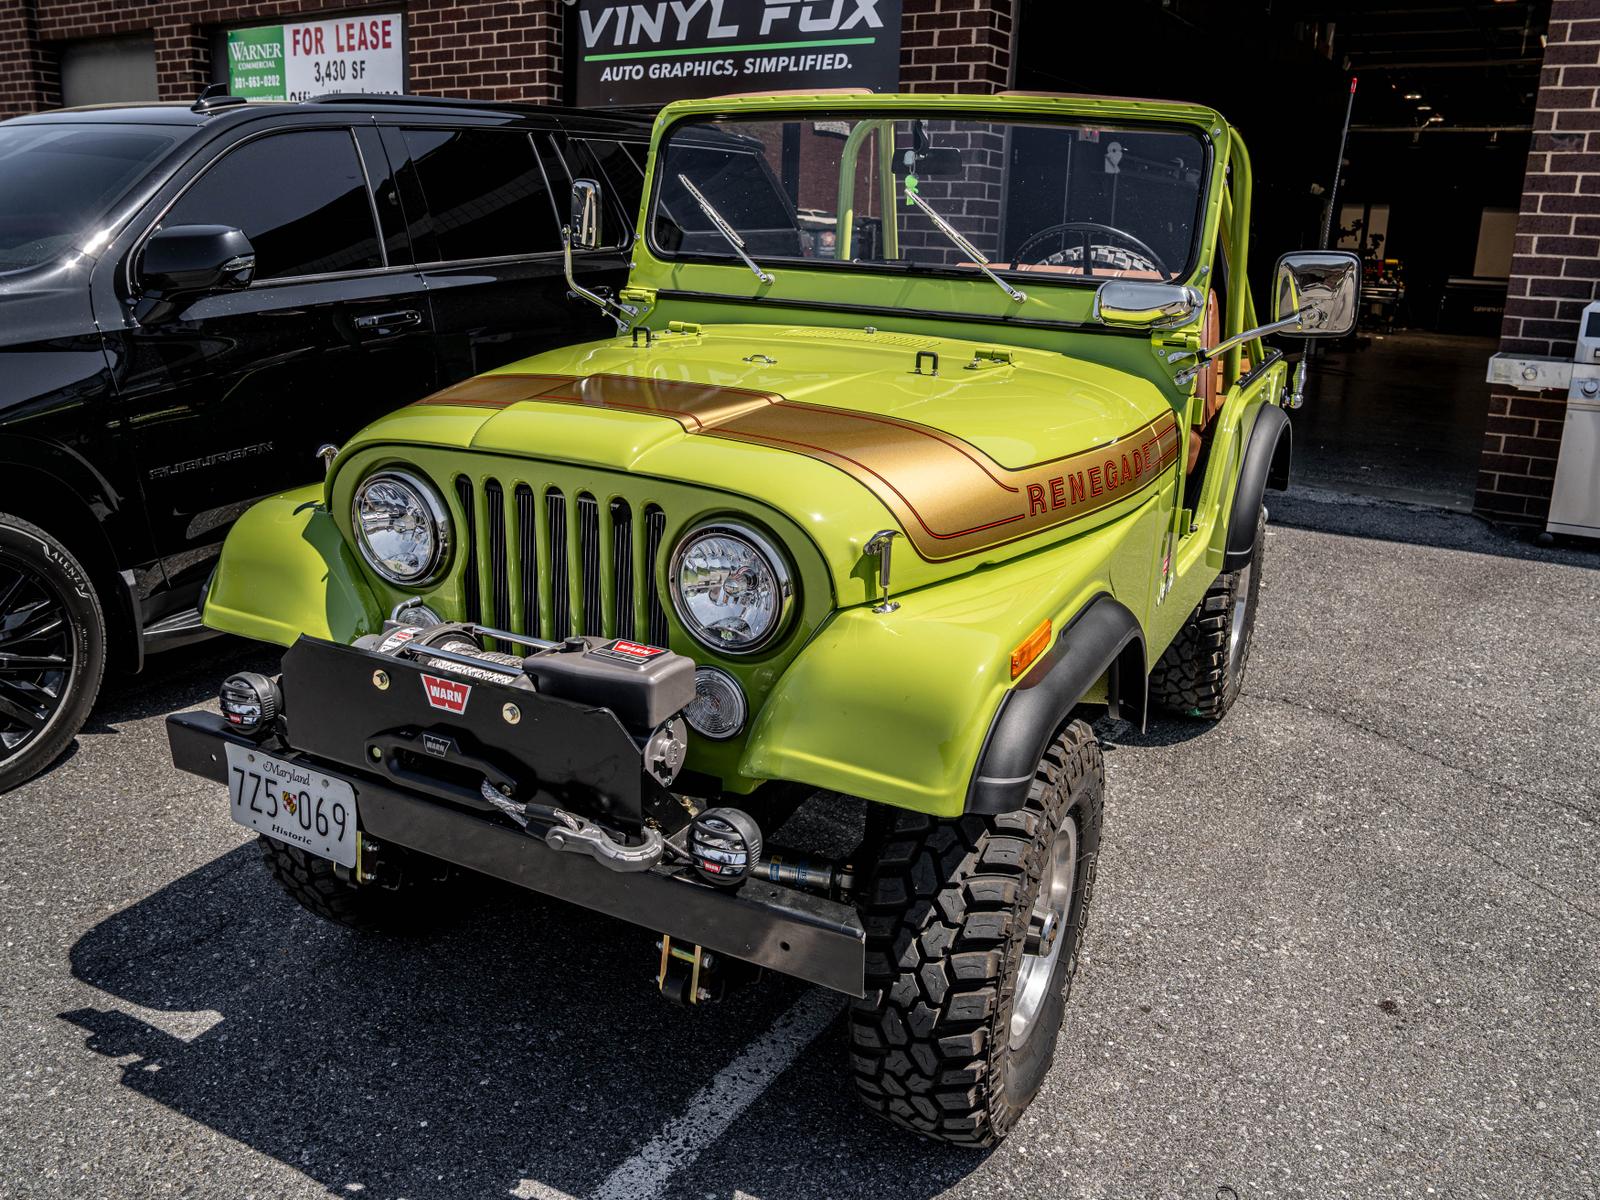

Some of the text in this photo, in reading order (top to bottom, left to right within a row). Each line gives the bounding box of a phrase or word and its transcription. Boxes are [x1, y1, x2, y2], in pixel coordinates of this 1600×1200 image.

[579, 0, 884, 48] VINYL FOX
[230, 41, 282, 61] WARNER
[292, 20, 392, 56] FOR LEASE
[238, 61, 276, 70] COMMERCIAL
[314, 60, 366, 87] 3,430 SF
[600, 53, 852, 82] AUTO GRAPHICS, SIMPLIFIED.
[149, 441, 273, 479] SUBURBAN
[1026, 442, 1152, 517] RENEGADE
[51, 551, 86, 590] ALENZA
[430, 685, 462, 704] WARN
[426, 741, 445, 752] WARN
[263, 761, 311, 786] Maryland
[271, 824, 313, 845] Historic
